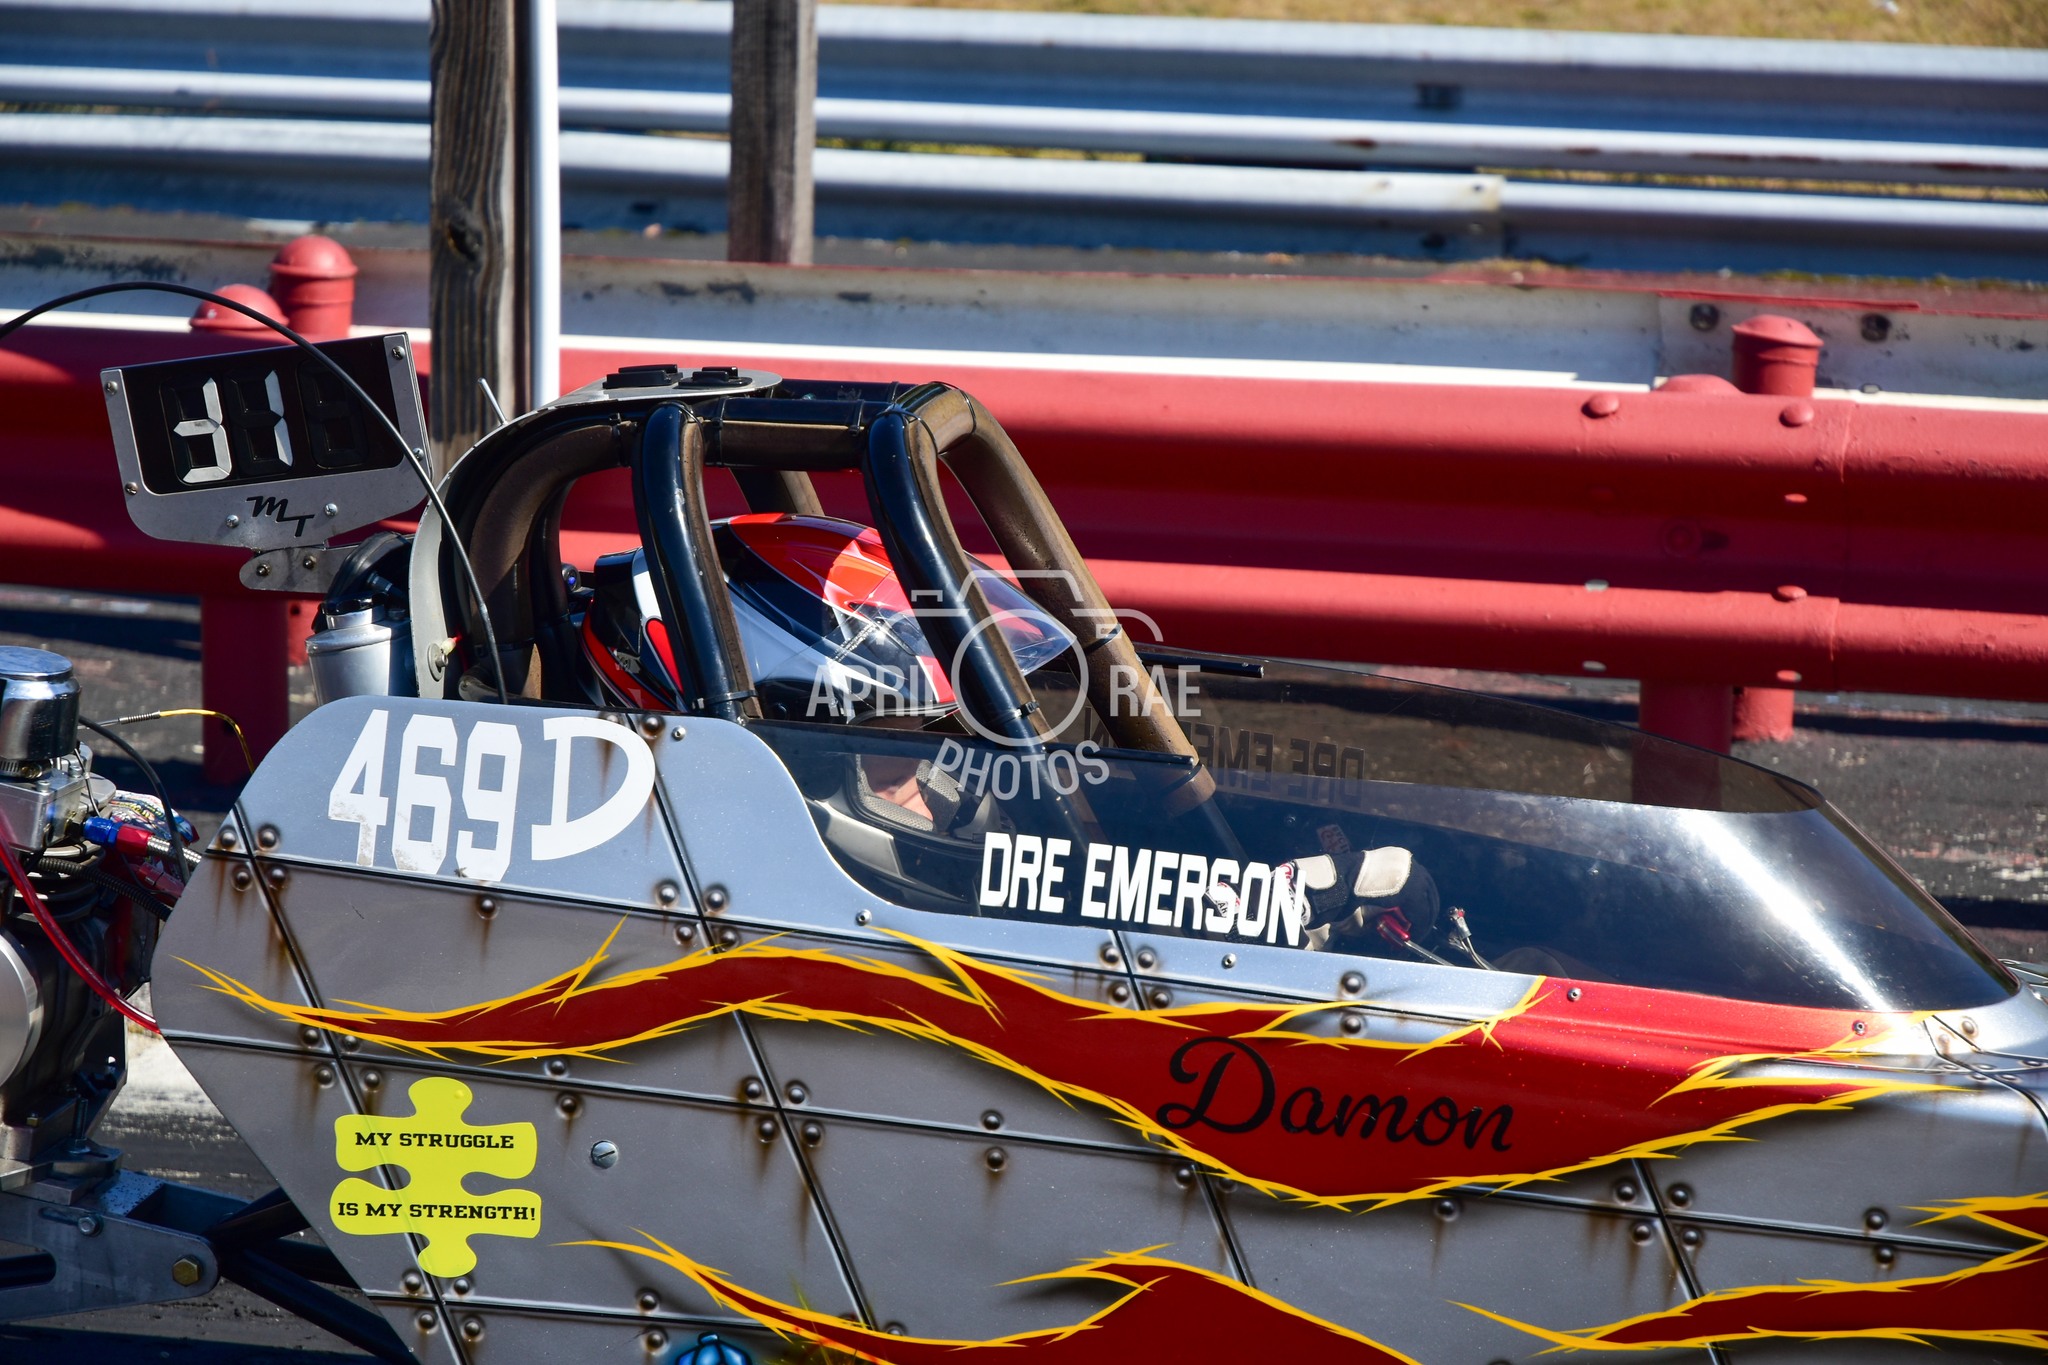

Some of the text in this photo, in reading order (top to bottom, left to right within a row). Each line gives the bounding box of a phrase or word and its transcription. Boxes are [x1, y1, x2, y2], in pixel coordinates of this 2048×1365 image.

[980, 832, 1307, 947] DRE EMERSON
[1156, 1036, 1514, 1152] Damon
[355, 1132, 514, 1149] MY STRUGGLE
[338, 1202, 536, 1221] IS MY STRENGTH!
